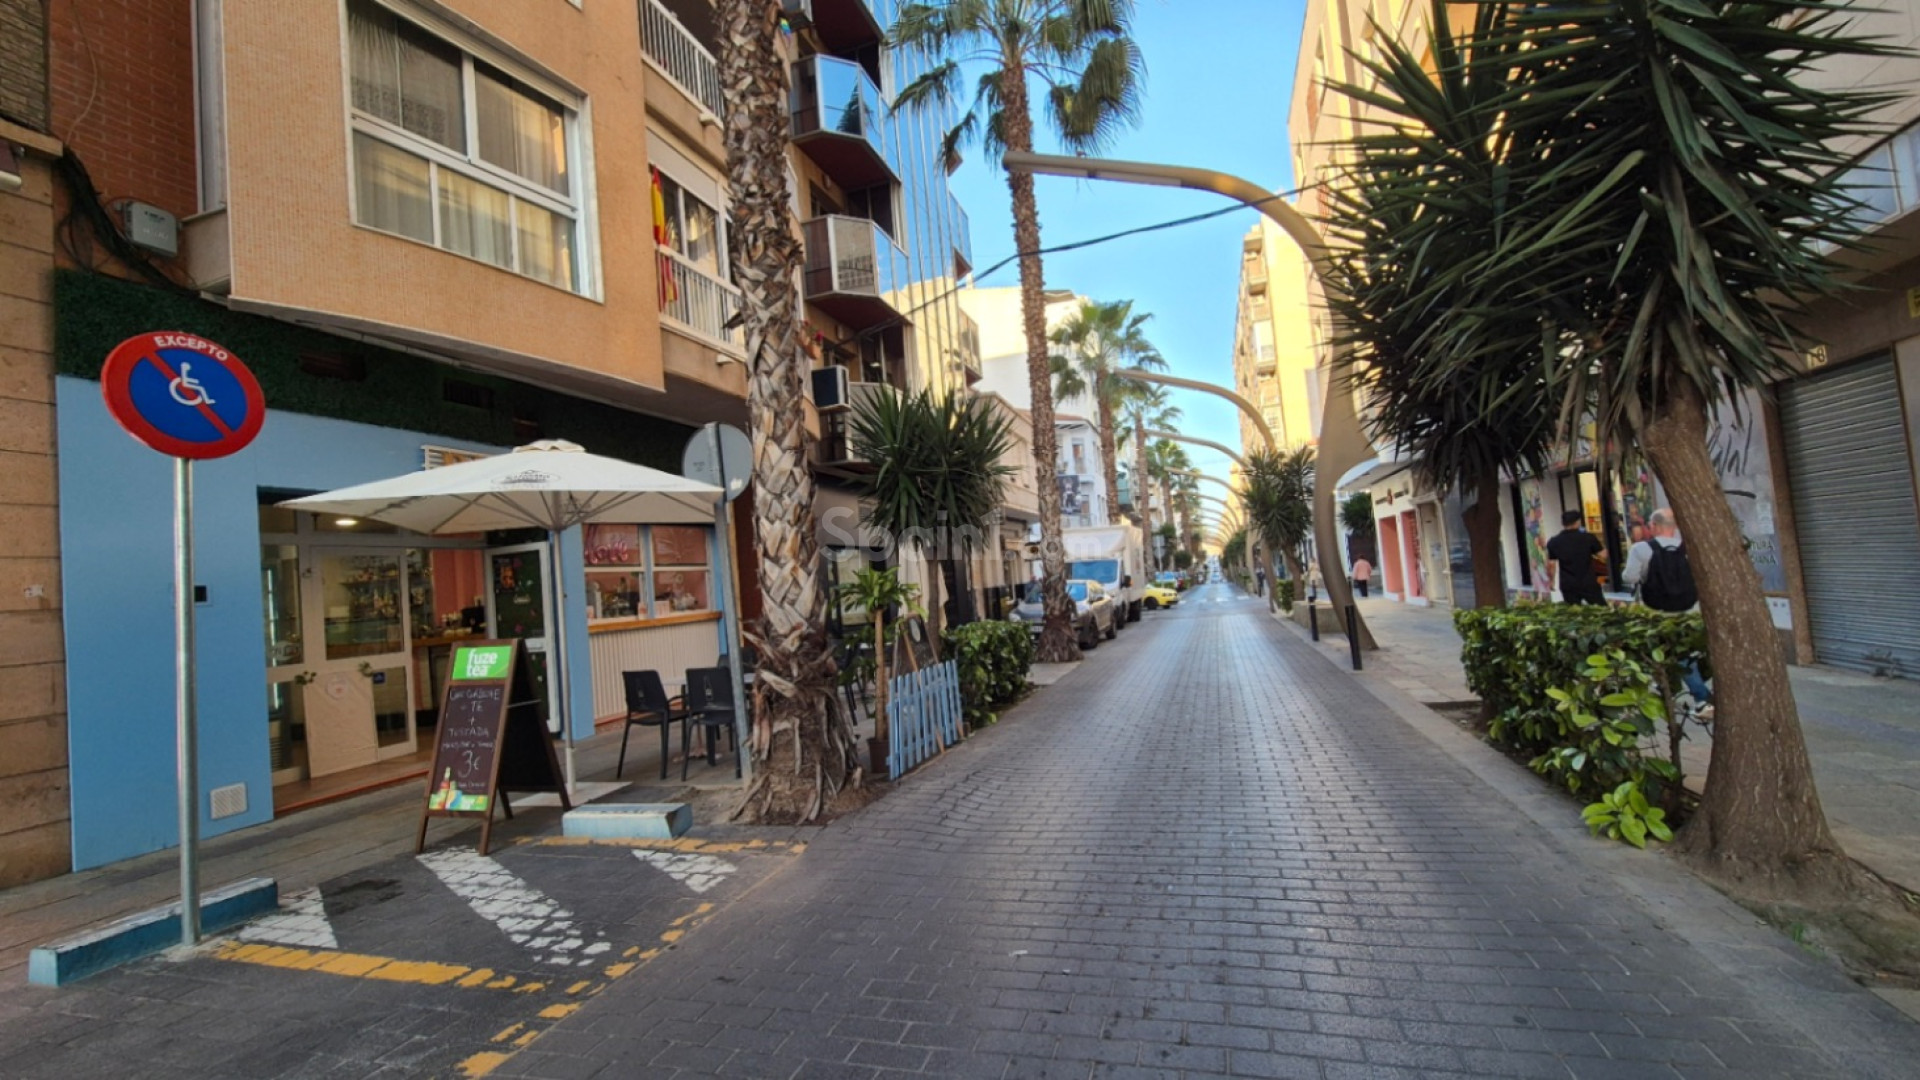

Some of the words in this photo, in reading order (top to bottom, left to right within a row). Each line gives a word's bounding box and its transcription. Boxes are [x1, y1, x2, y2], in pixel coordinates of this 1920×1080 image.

[153, 334, 229, 361] EXCEPTO
[467, 648, 498, 665] fuze
[466, 663, 490, 677] tea
